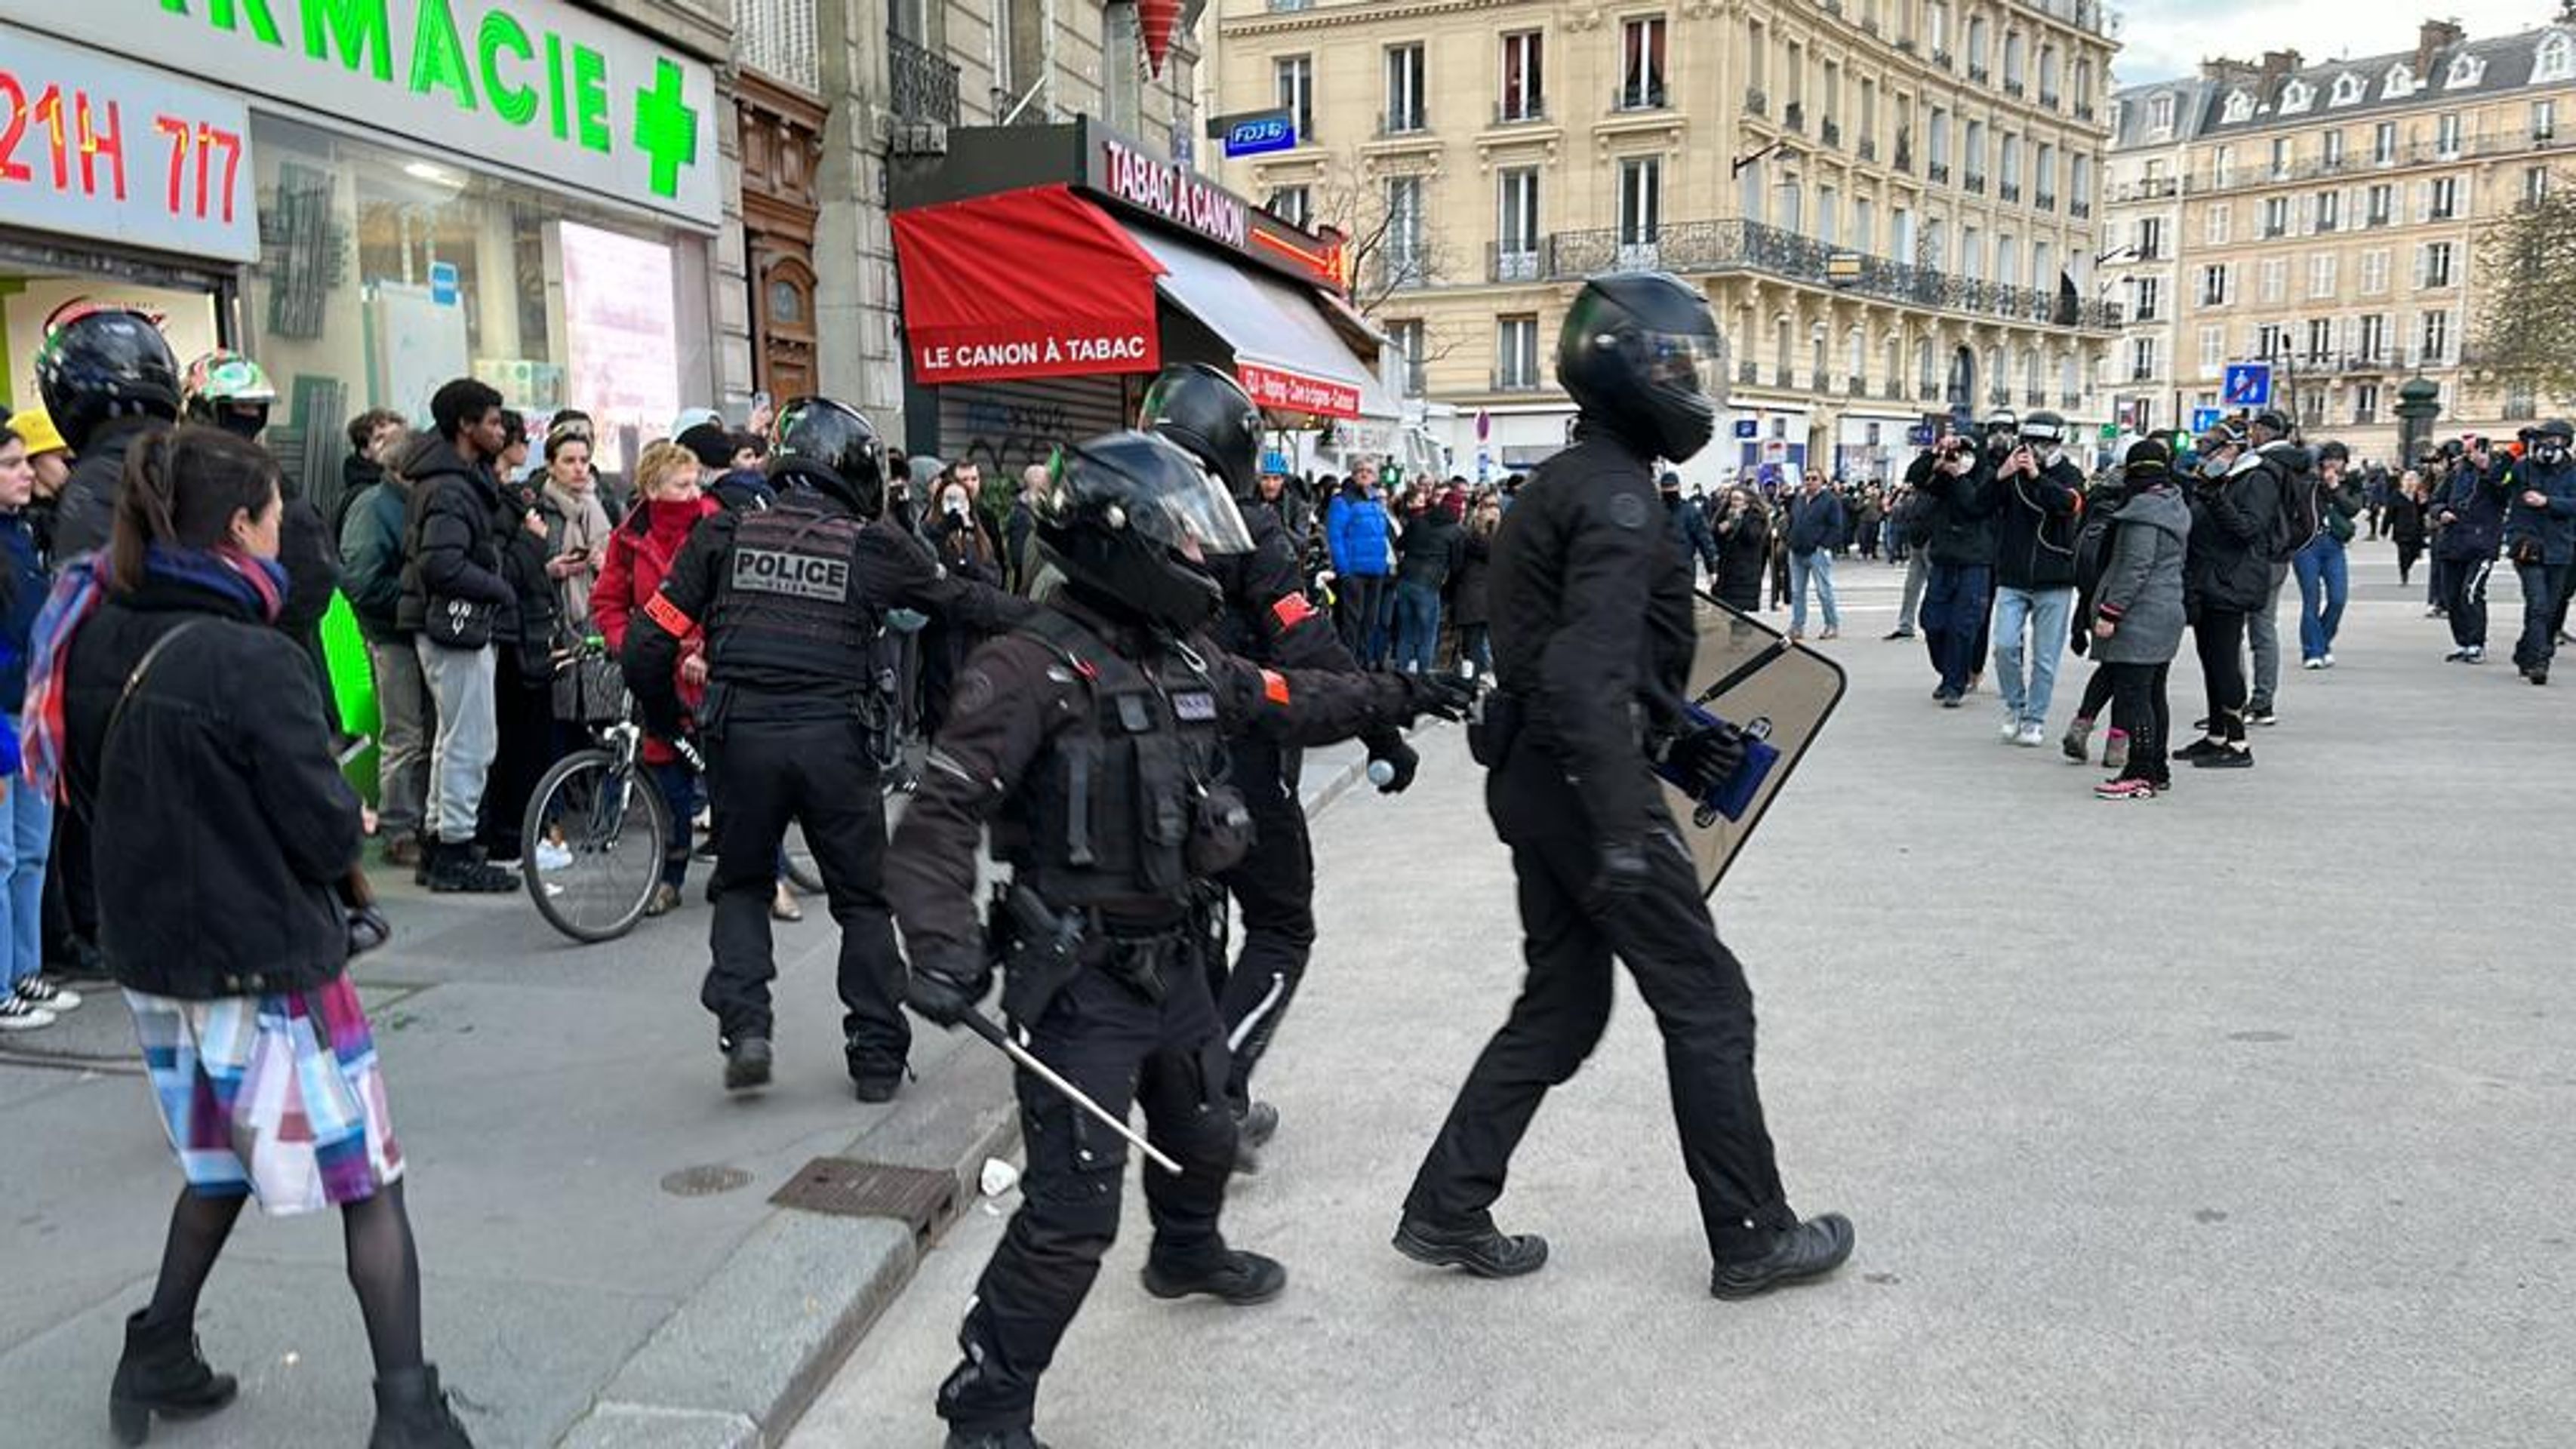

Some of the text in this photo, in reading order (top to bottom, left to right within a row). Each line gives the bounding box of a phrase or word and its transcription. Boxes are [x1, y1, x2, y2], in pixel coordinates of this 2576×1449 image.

[159, 0, 611, 154] MACIE
[155, 115, 241, 223] 7/7
[1107, 140, 1245, 248] TABAC À CANON
[923, 337, 1145, 368] LE CANON À TABAC
[737, 552, 846, 587] POLICE
